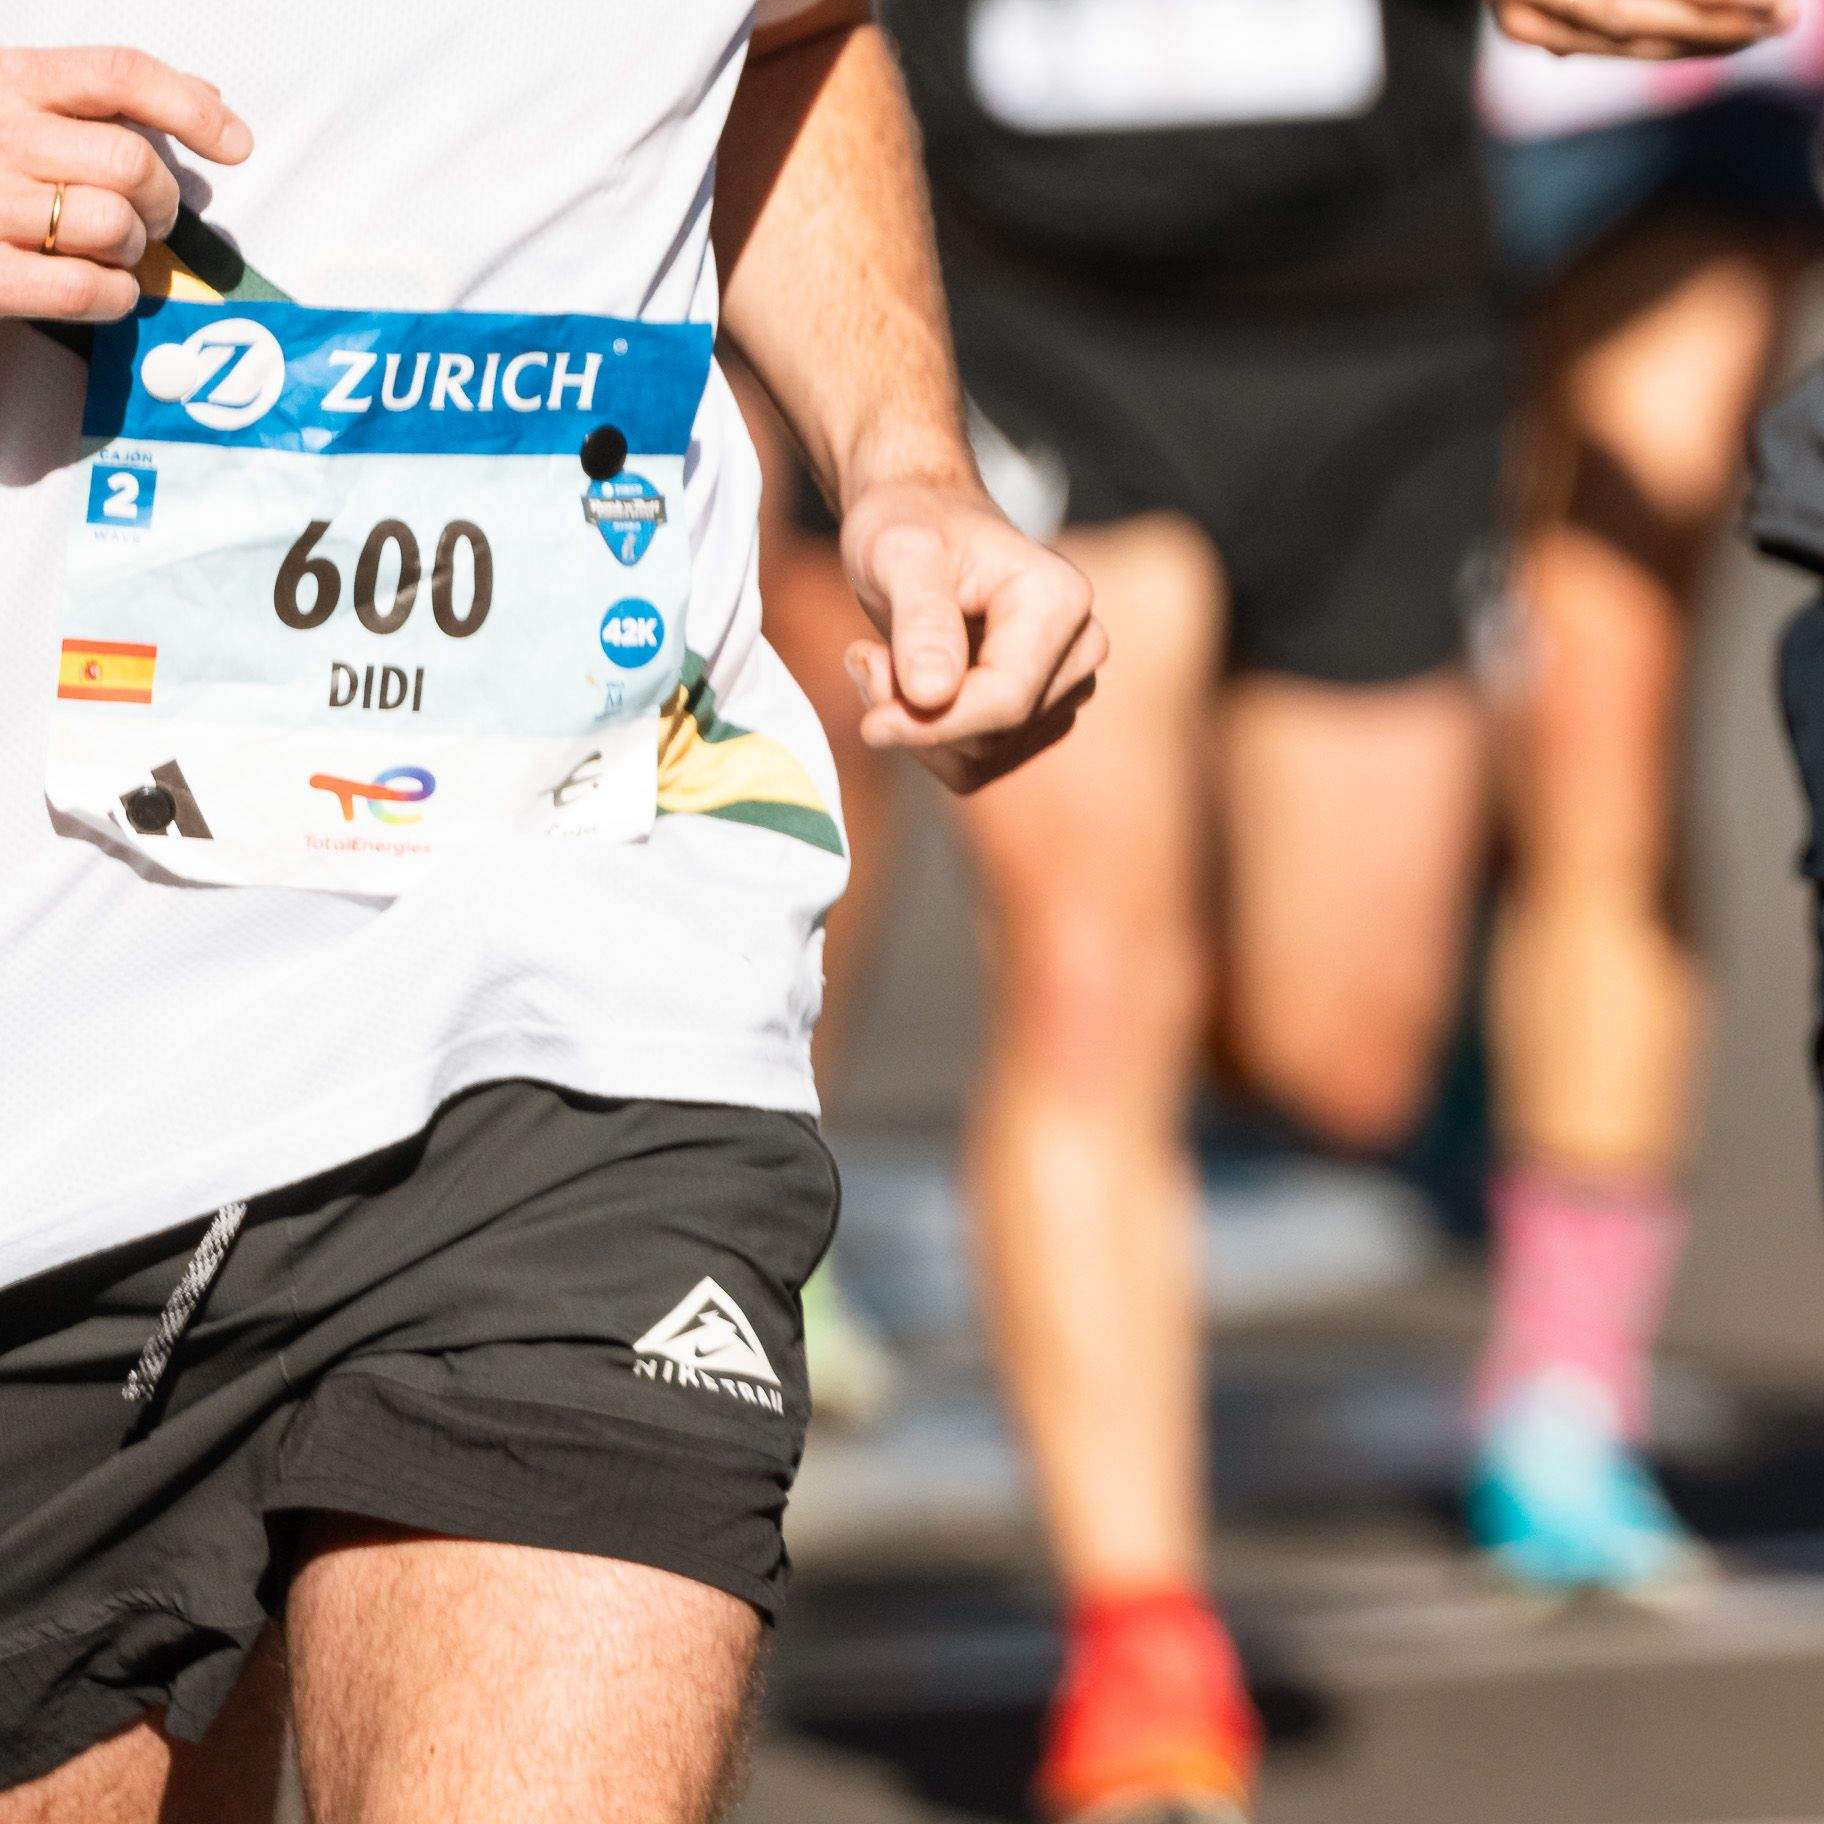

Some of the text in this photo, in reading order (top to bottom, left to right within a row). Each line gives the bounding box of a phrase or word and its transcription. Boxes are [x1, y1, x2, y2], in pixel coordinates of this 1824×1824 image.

[320, 351, 602, 413] ZURICH
[103, 472, 139, 519] 2
[273, 518, 494, 639] 600
[602, 617, 657, 647] 42K
[329, 661, 424, 713] DIDI
